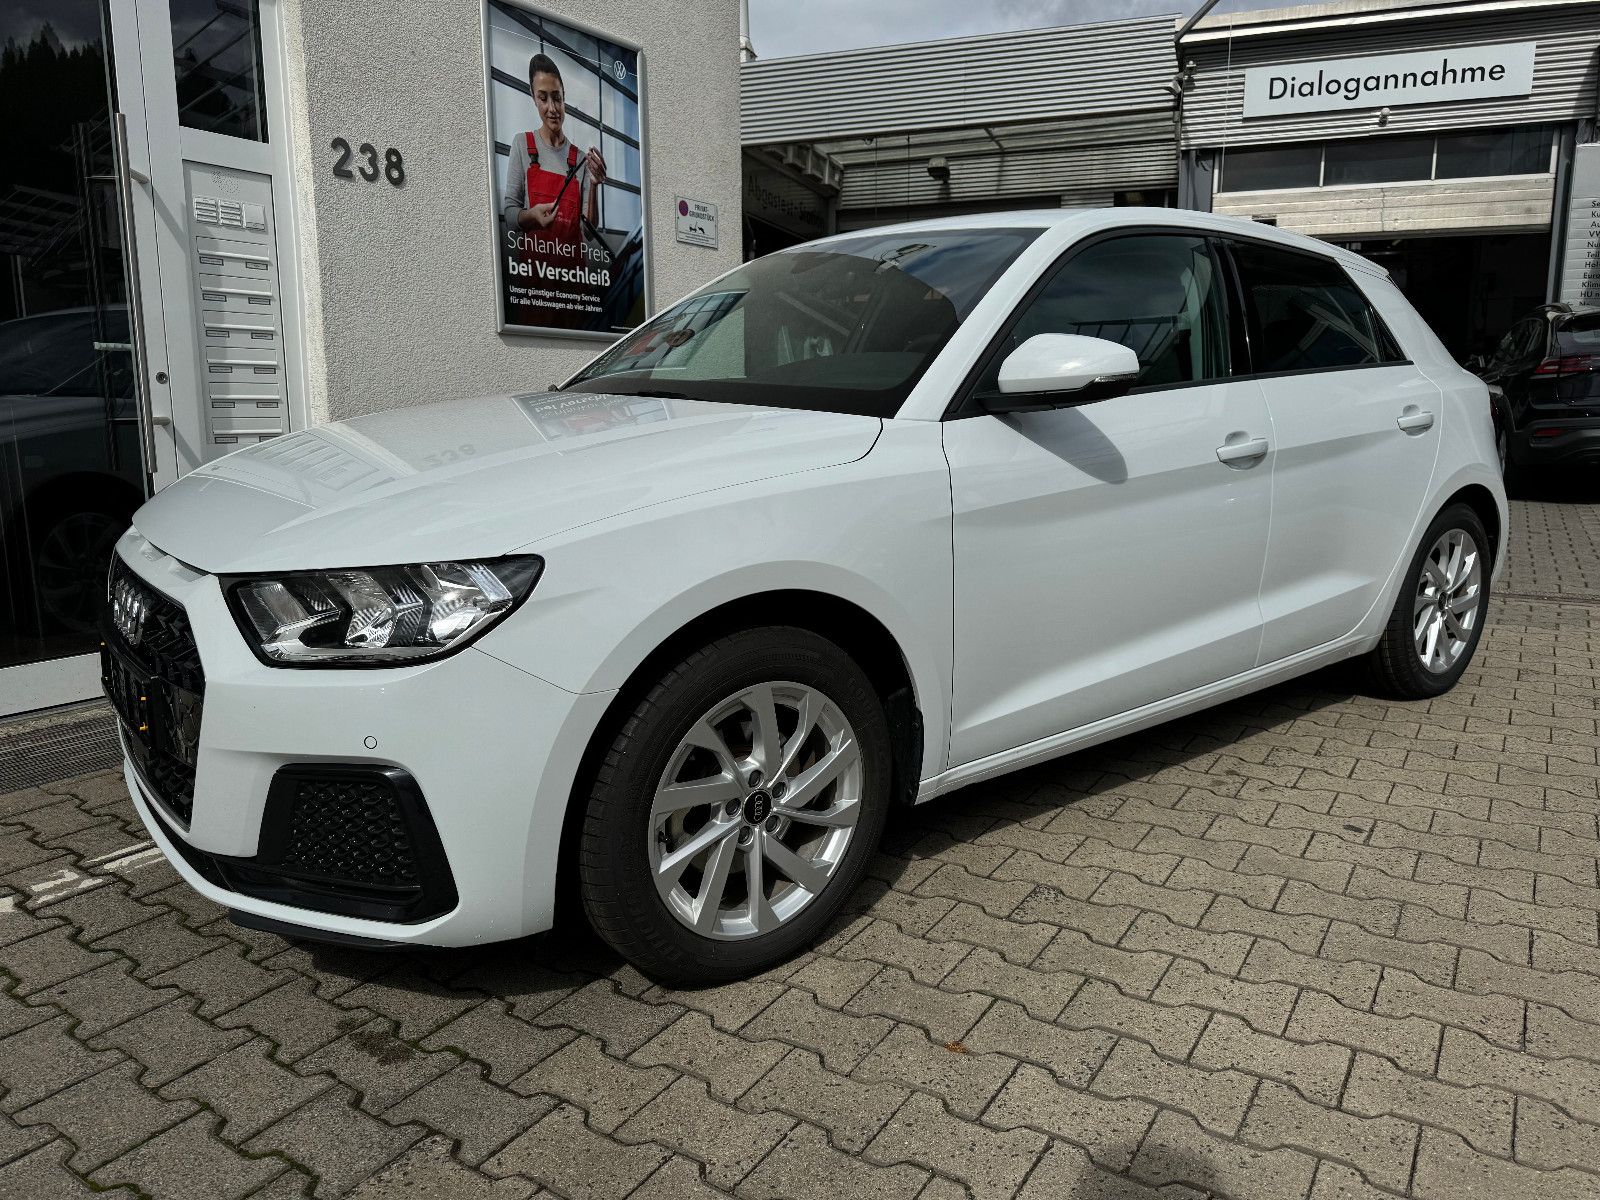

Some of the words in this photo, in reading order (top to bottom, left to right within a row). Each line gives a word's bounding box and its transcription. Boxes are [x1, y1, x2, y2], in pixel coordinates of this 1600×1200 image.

[1268, 58, 1506, 100] Dialogannahme
[330, 137, 405, 186] 238
[507, 230, 577, 257] Schlanker
[580, 242, 610, 263] Preis
[508, 256, 533, 276] bei
[535, 260, 611, 287] Verschleiß
[509, 285, 527, 294] Unser
[528, 287, 555, 298] günstiger
[555, 290, 581, 301] Economy
[581, 293, 601, 302] Service
[510, 295, 519, 304] für
[520, 297, 531, 305] alle
[531, 298, 566, 310] Volkswagen
[574, 303, 585, 311] vier
[585, 304, 603, 313] Jahren
